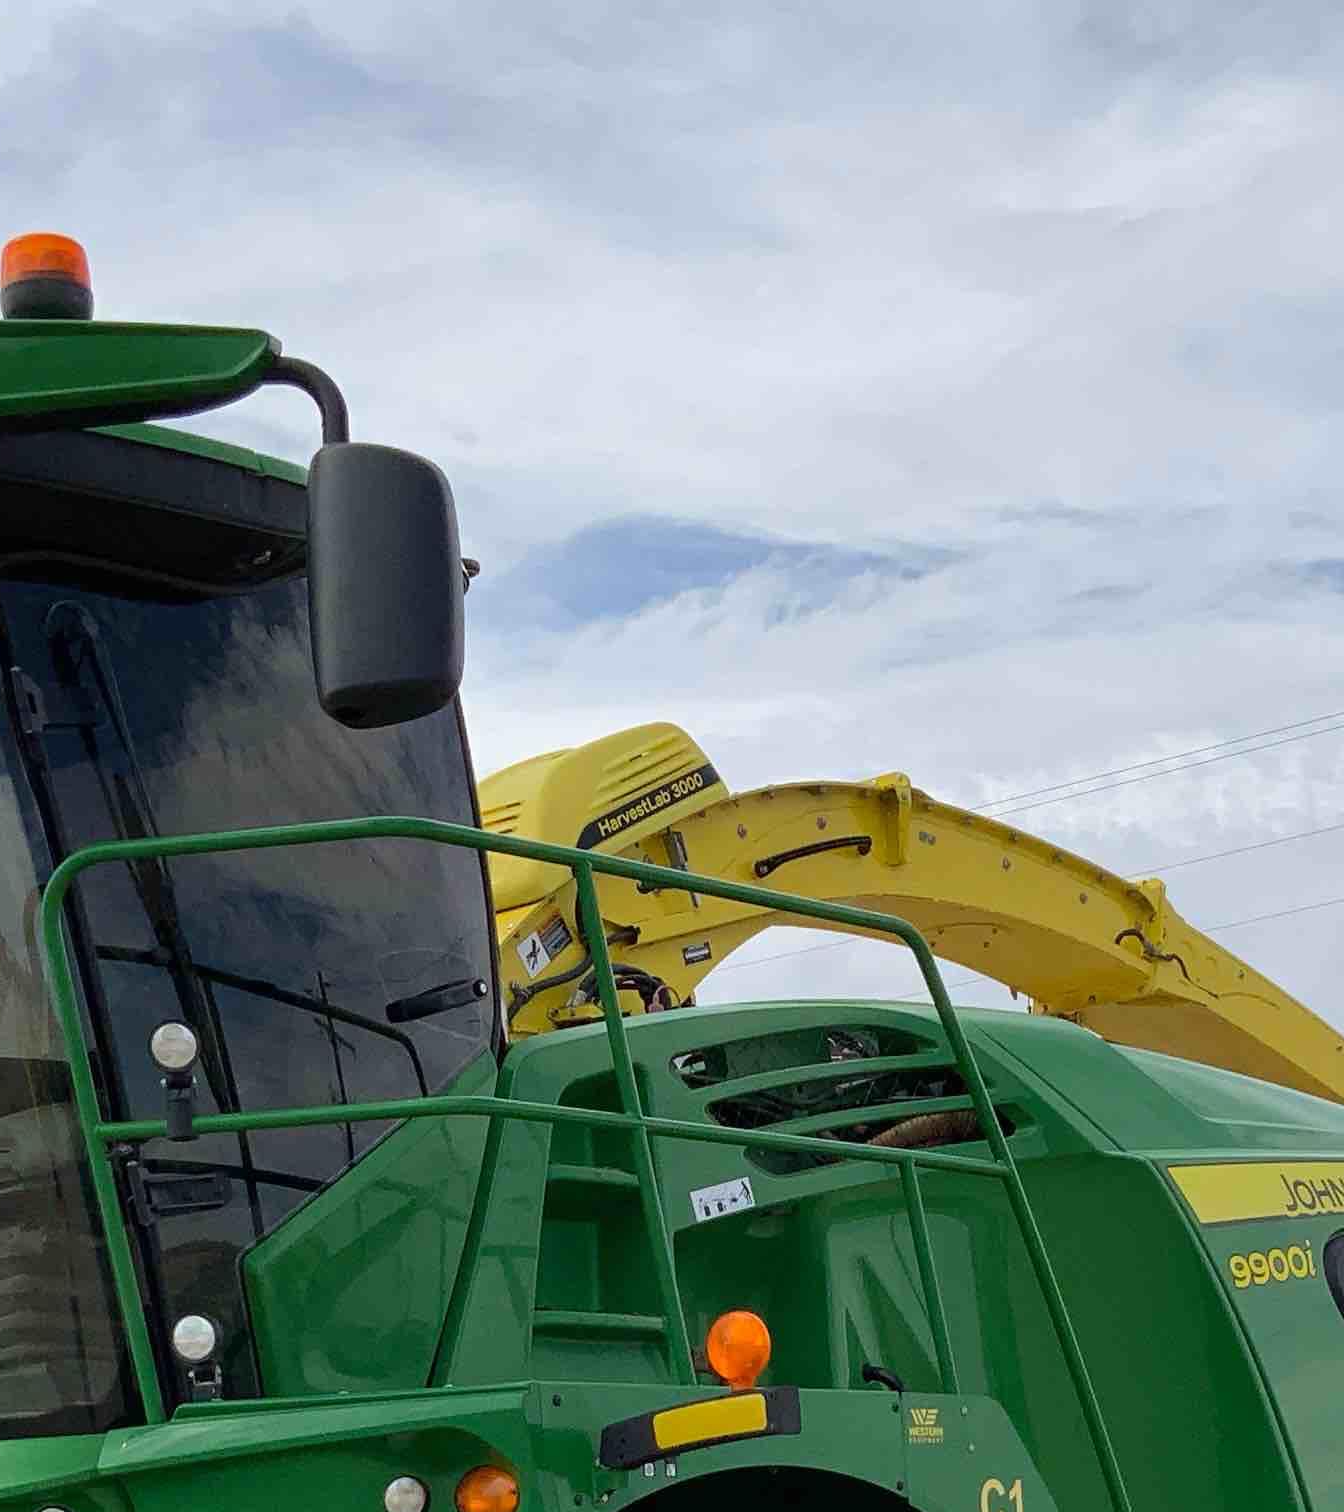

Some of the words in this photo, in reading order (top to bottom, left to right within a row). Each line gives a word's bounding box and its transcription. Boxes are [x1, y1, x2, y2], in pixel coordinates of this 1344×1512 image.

[598, 788, 672, 837] HarvestLab
[671, 772, 704, 798] 3000
[1229, 1240, 1316, 1289] 9900i
